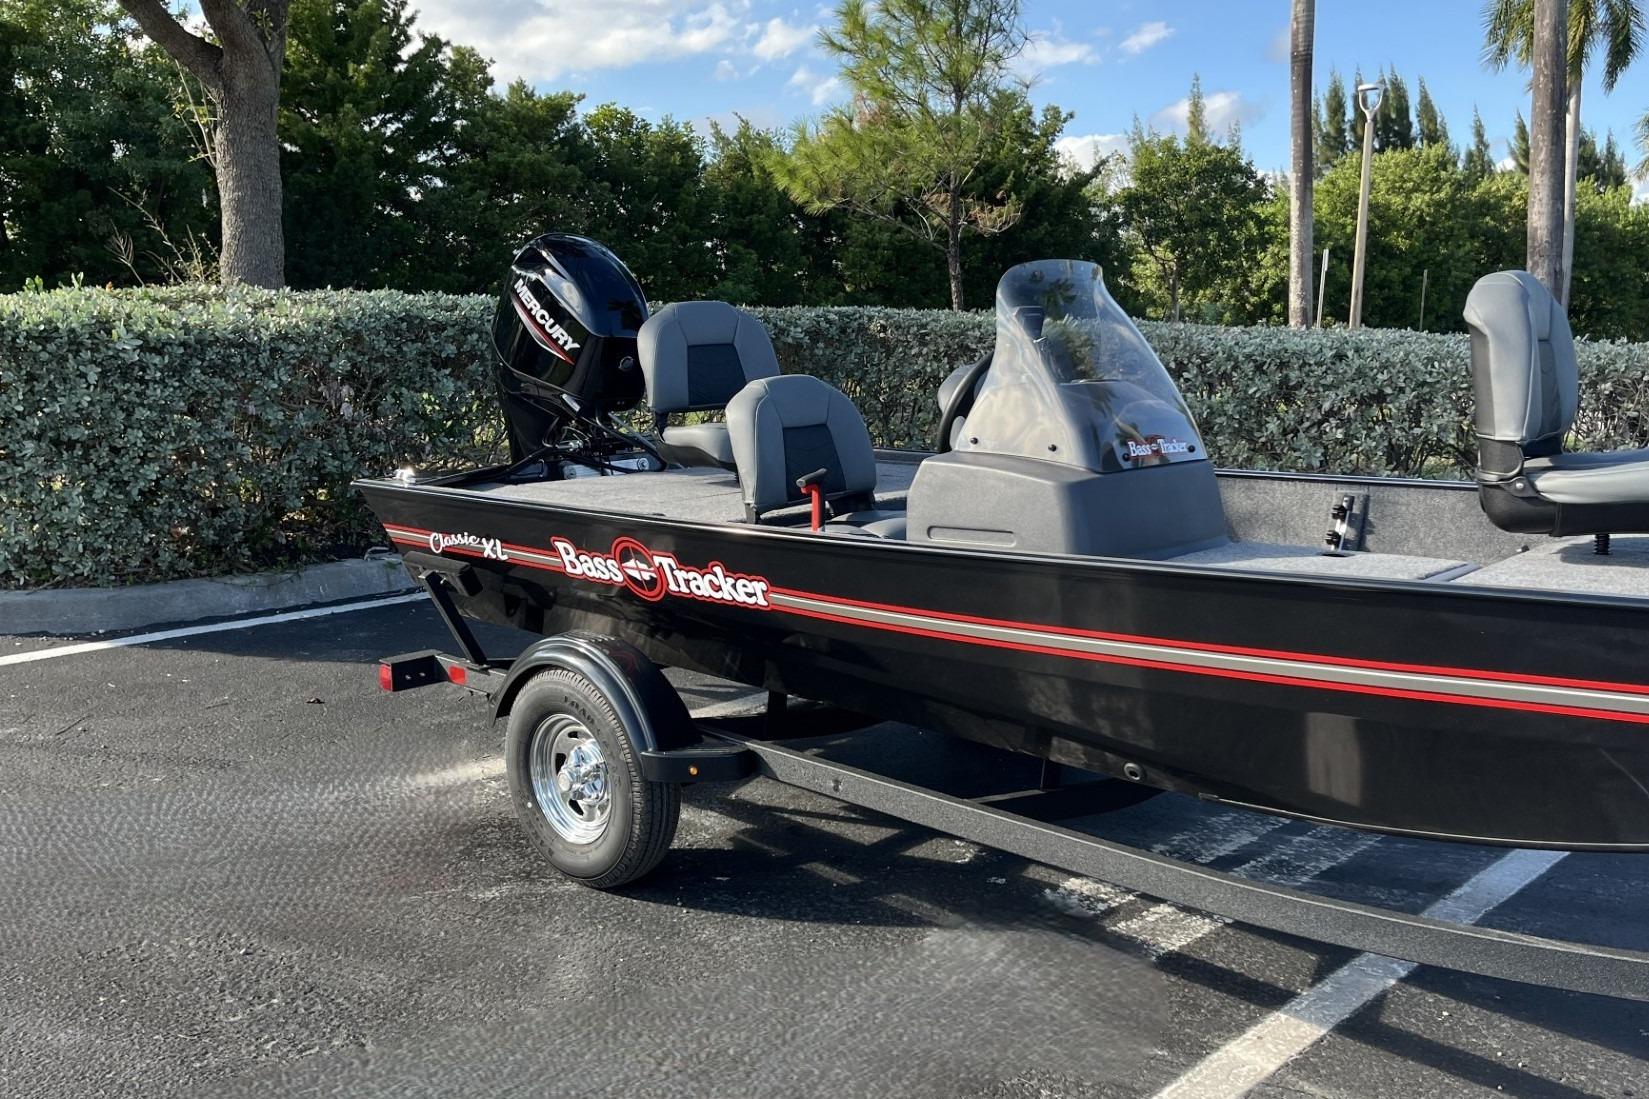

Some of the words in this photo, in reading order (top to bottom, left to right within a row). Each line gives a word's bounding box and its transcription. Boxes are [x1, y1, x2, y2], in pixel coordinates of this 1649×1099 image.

[514, 279, 580, 351] MERCURY
[1128, 441, 1152, 456] Bass
[430, 532, 480, 553] Classic
[482, 537, 508, 560] XL
[553, 541, 624, 583] Bass
[652, 555, 769, 606] Tracker
